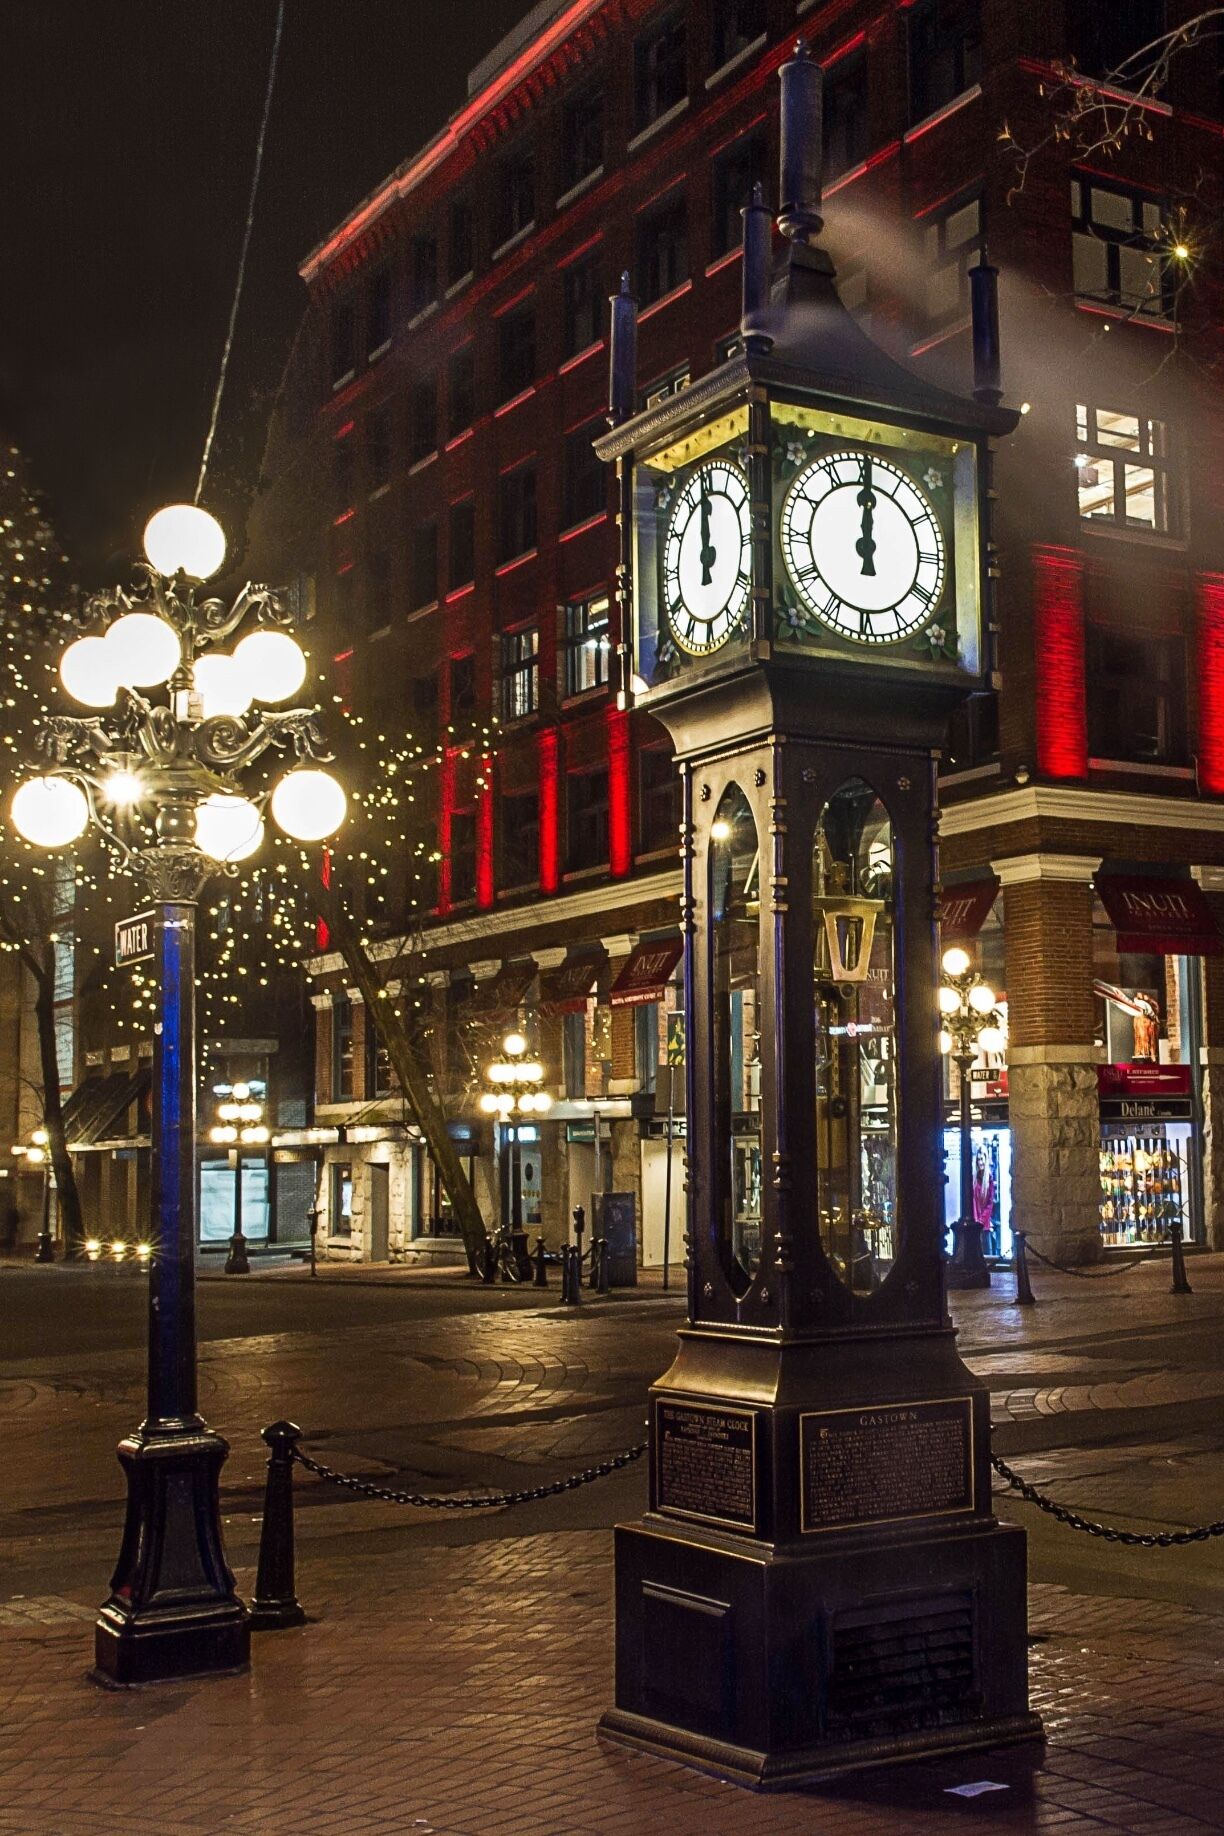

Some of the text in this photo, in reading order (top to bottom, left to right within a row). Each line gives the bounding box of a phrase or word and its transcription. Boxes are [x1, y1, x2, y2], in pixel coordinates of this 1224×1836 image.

[1122, 890, 1189, 912] INUIT
[120, 923, 148, 956] WATER
[867, 967, 889, 981] NUIT
[860, 1411, 919, 1426] GASTOWN
